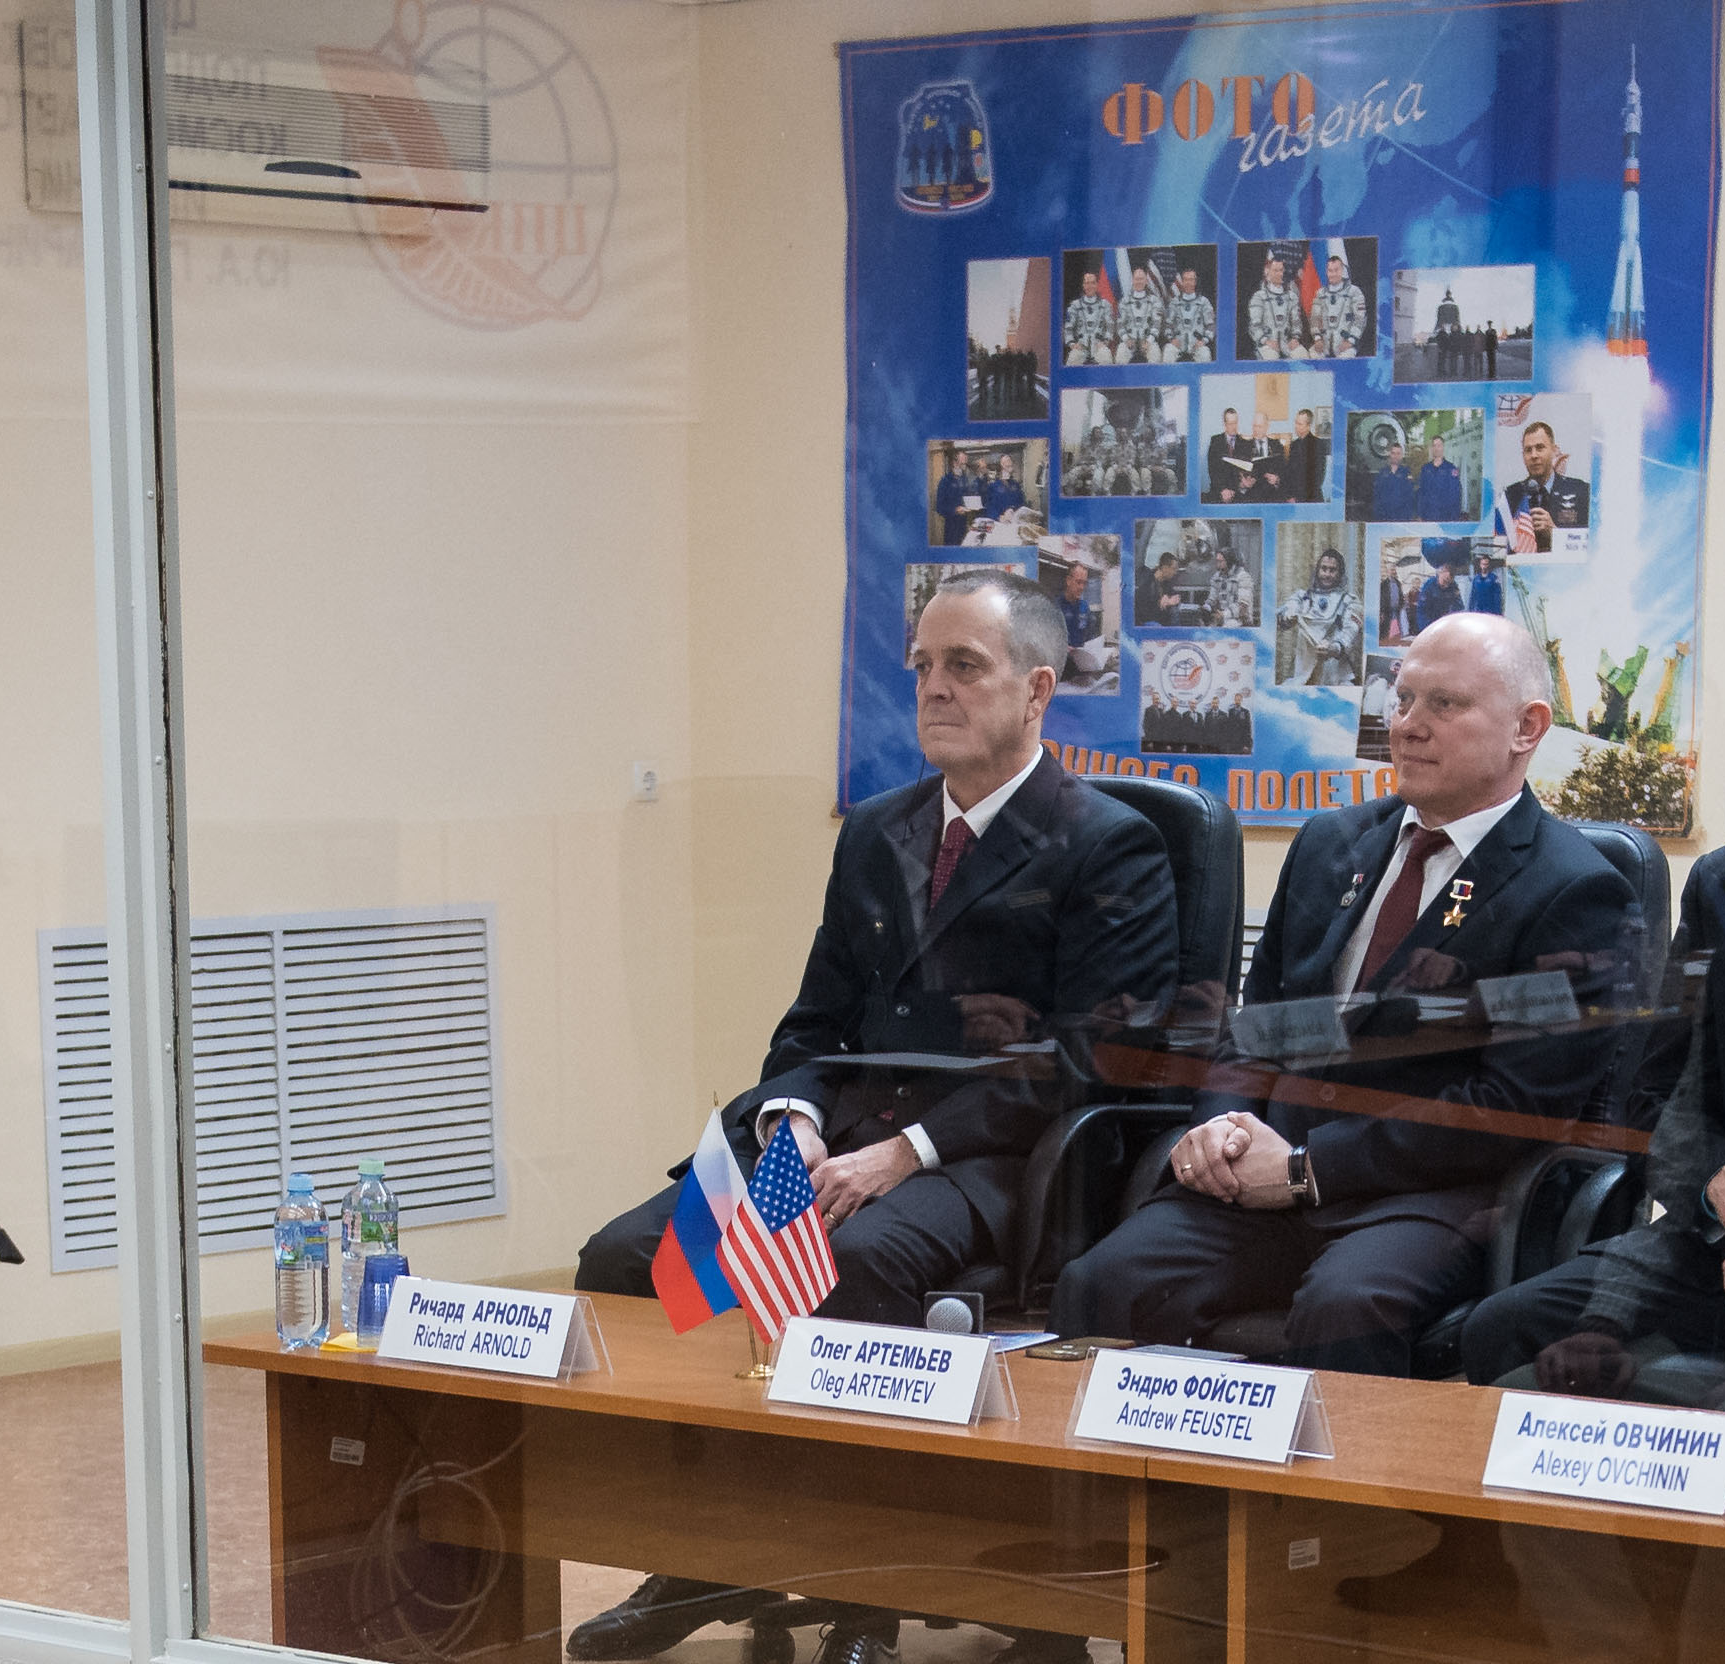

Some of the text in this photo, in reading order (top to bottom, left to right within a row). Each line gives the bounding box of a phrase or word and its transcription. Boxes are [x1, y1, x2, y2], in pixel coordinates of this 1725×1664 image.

[1102, 71, 1428, 173] ФОТО газета
[409, 1292, 552, 1334] Ричард АРНОЛЬД
[413, 1324, 532, 1359] Richard ARNOLD
[810, 1334, 953, 1373] Олег АРТЕМЬЕВ
[810, 1367, 936, 1404] Oleg ARTEMYEV
[1117, 1367, 1277, 1408] Эндрю ФОЙСТЕЛ
[1116, 1401, 1253, 1441] Andrew FEUSTEL
[1517, 1411, 1723, 1458] Алексей ОВЧИНИН
[1531, 1449, 1690, 1492] Alexey OVCHININ
